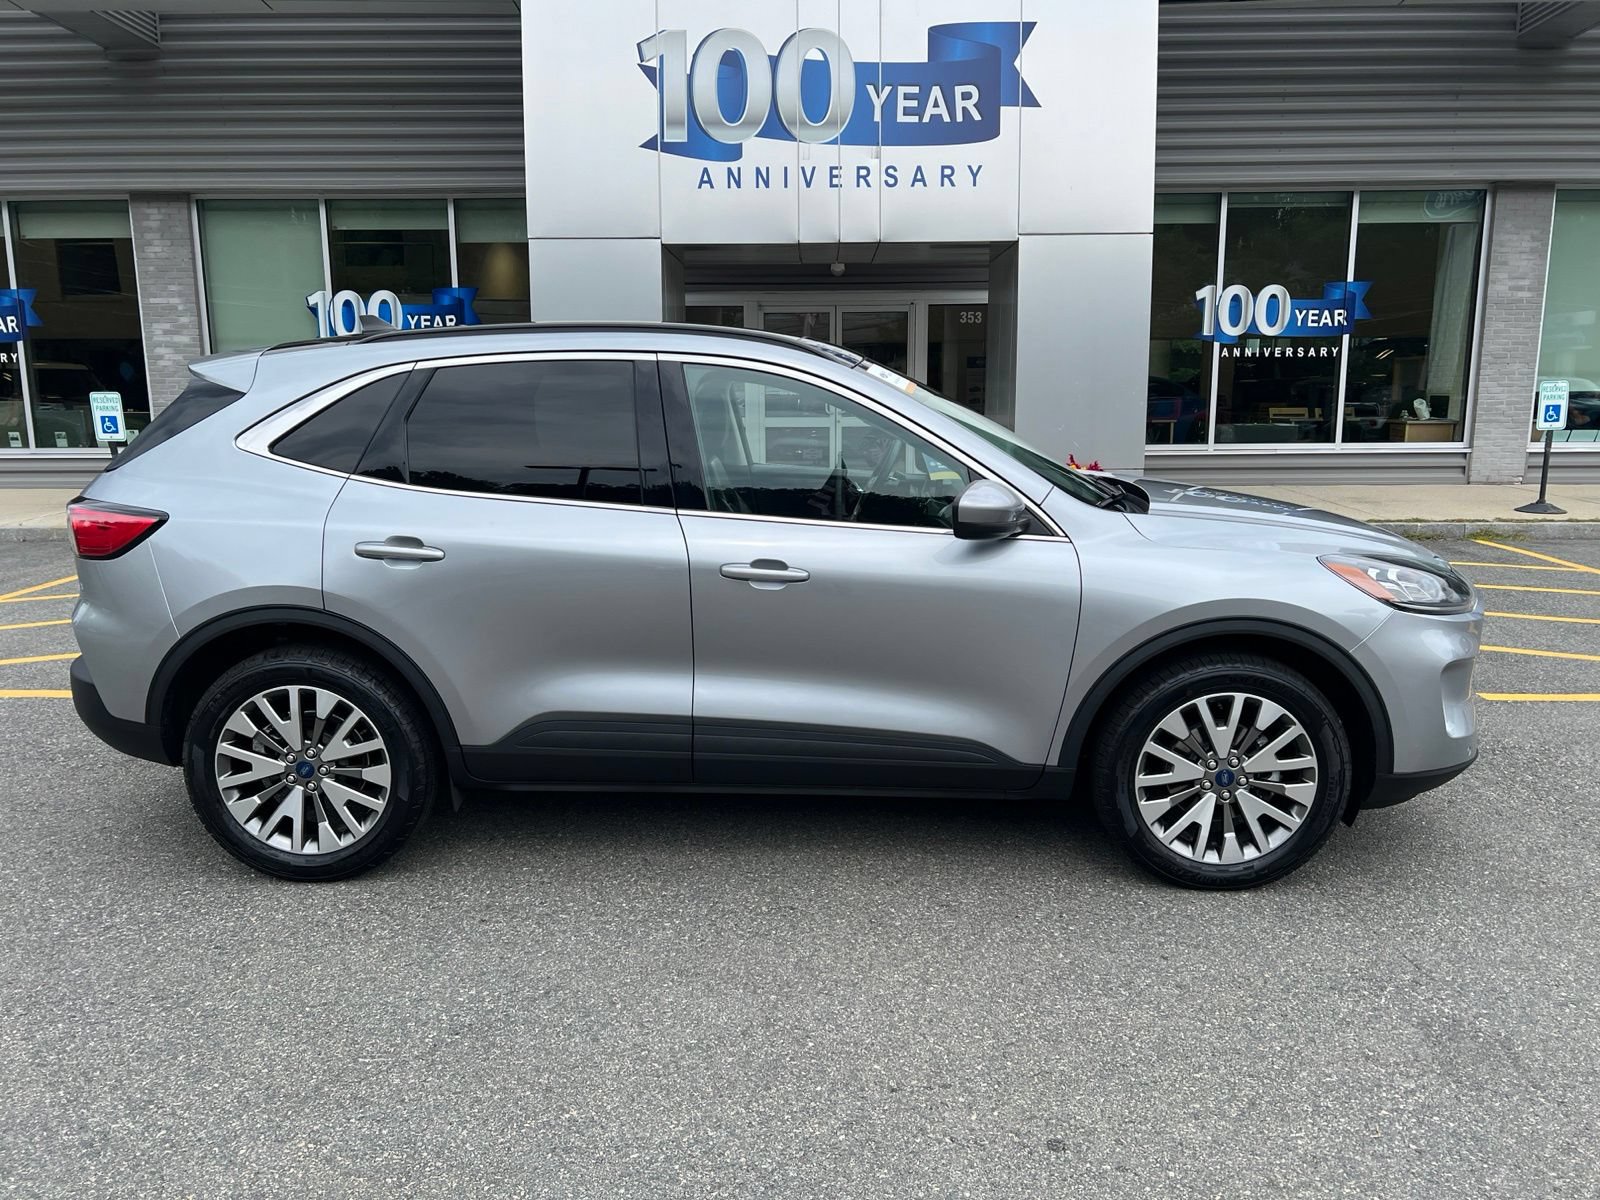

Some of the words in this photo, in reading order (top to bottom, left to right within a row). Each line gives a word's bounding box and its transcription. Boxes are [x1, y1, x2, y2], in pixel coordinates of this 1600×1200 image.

[637, 27, 856, 144] 100
[865, 84, 982, 124] YEAR
[697, 164, 983, 189] ANNIVERSARY
[306, 290, 403, 338] 100
[960, 311, 982, 324] 353
[1195, 284, 1291, 336] 100
[1295, 309, 1347, 327] YEAR
[1221, 346, 1339, 358] ANNIVERSARY
[1543, 393, 1565, 401] PARKING
